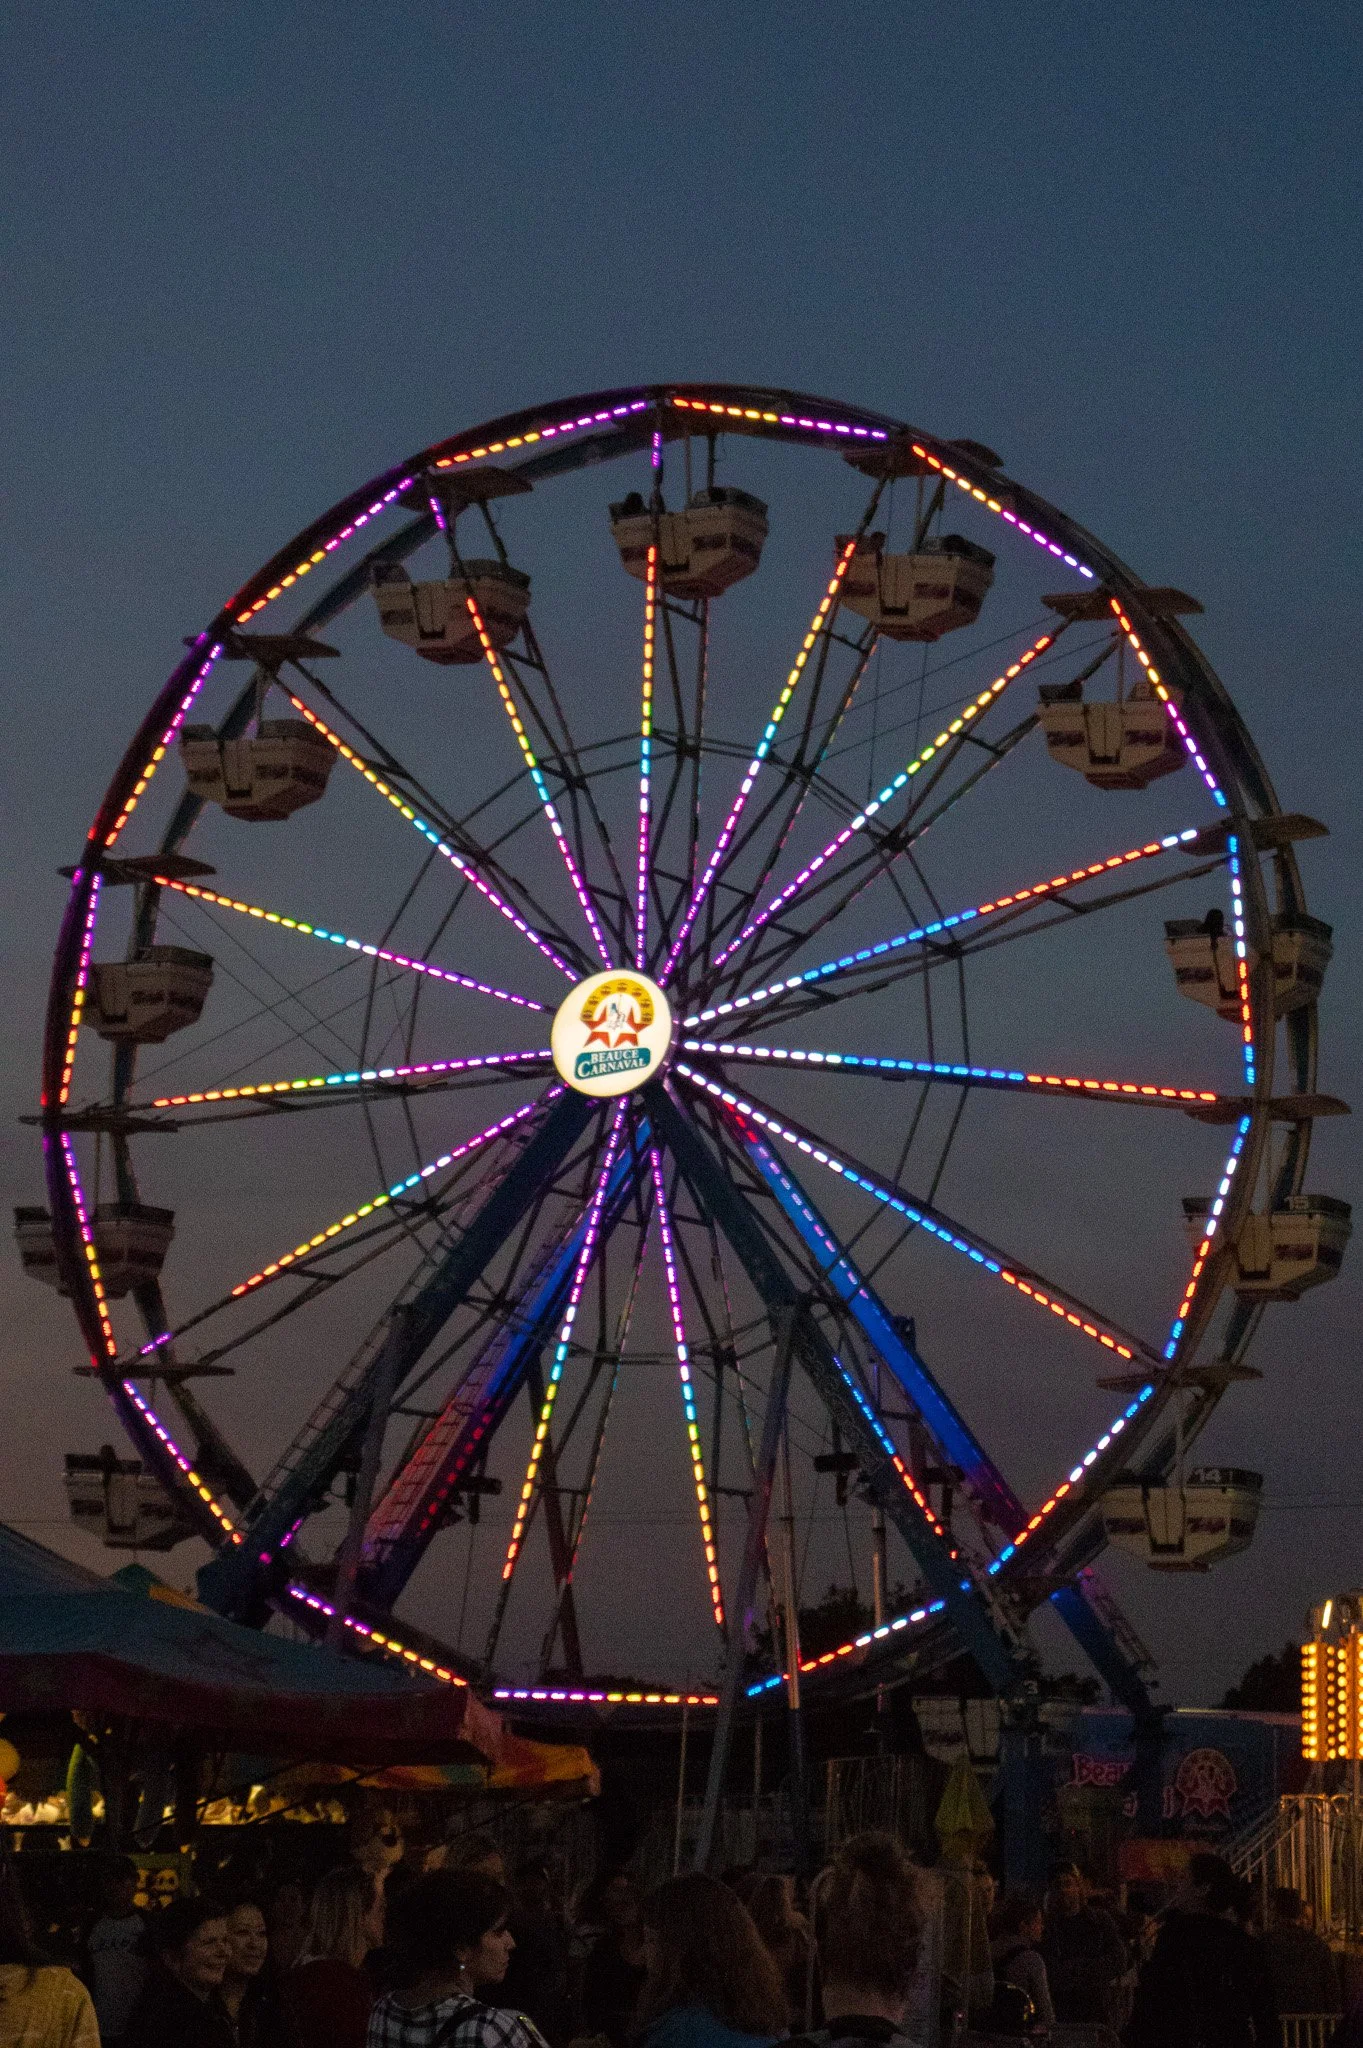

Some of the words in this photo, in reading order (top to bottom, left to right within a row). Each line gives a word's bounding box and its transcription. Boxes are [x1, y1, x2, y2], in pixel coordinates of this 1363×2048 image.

[590, 1049, 640, 1064] BEAUCE
[577, 1057, 647, 1078] CARNAVAL
[1195, 1469, 1221, 1483] 14
